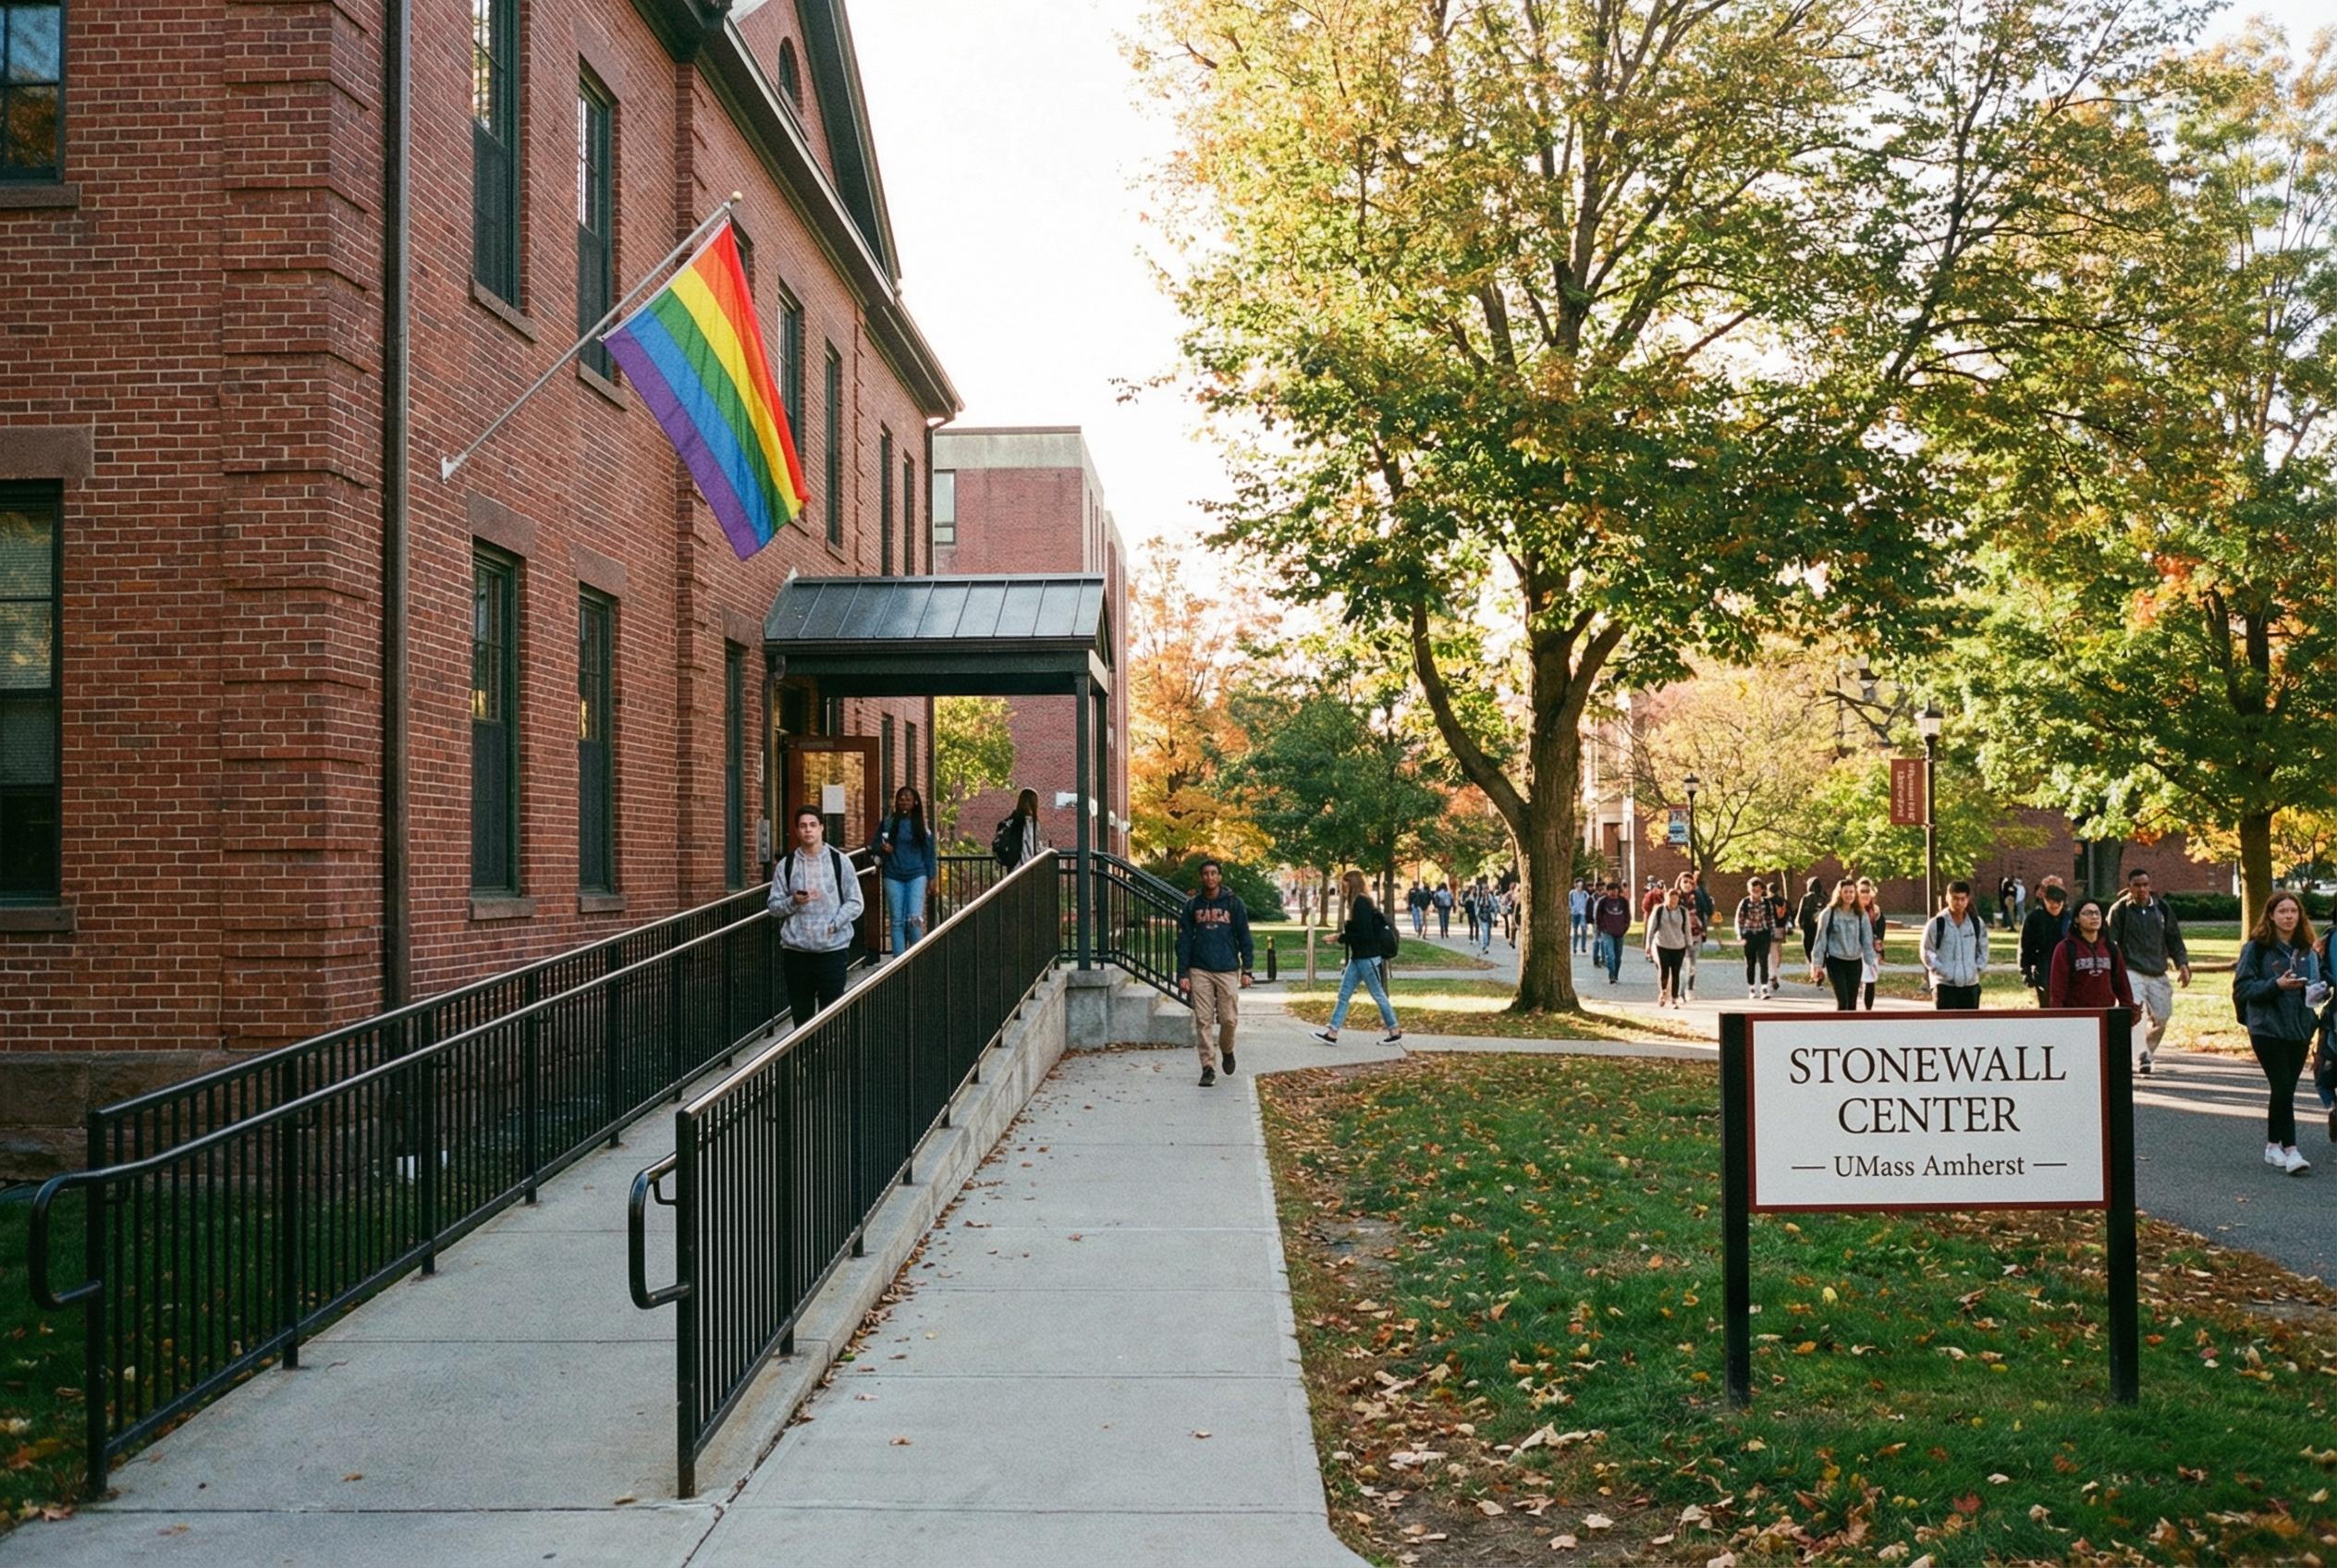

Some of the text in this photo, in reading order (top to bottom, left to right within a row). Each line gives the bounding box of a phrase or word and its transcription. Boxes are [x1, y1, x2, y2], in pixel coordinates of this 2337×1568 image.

[1790, 1046, 2067, 1084] STONEWALL
[1838, 1096, 2021, 1134] CENTER
[1834, 1153, 2025, 1178] UMass Amherst
